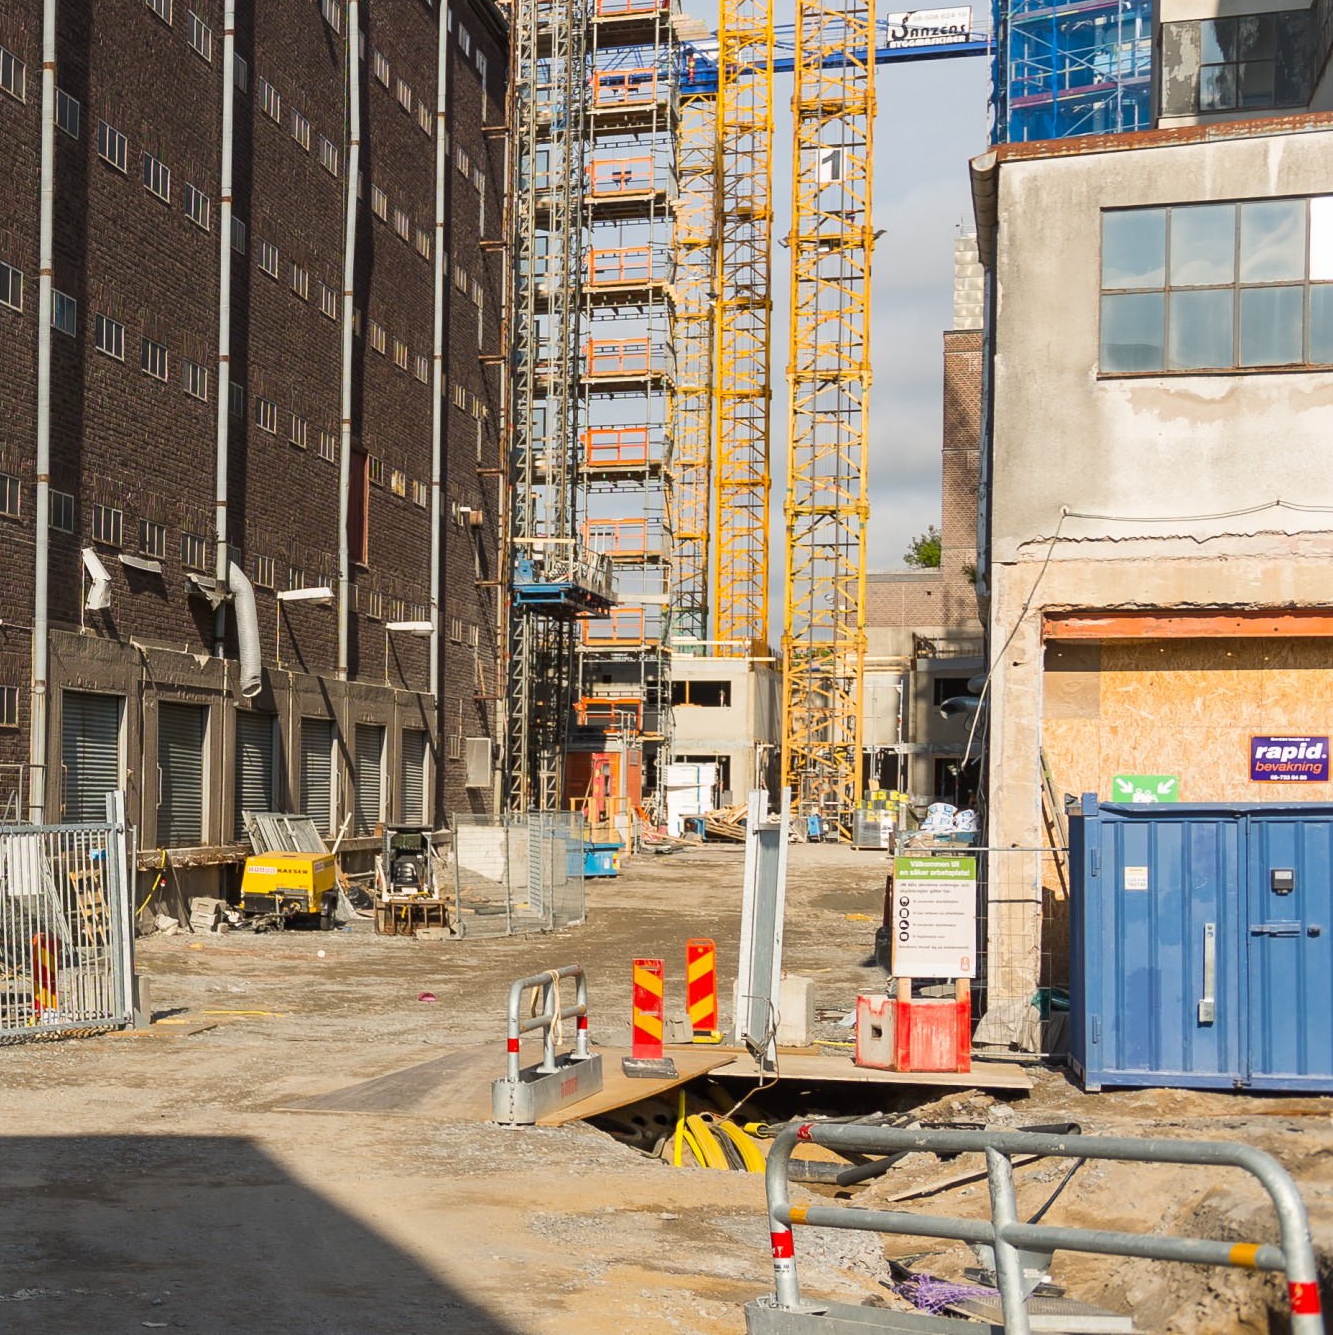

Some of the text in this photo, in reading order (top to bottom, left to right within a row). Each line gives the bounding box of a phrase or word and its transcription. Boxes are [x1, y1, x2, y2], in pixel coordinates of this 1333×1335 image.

[890, 35, 966, 49] BYGGMASKINER
[821, 150, 840, 181] 1
[1255, 761, 1322, 775] bevakning
[909, 860, 950, 868] Välkommen
